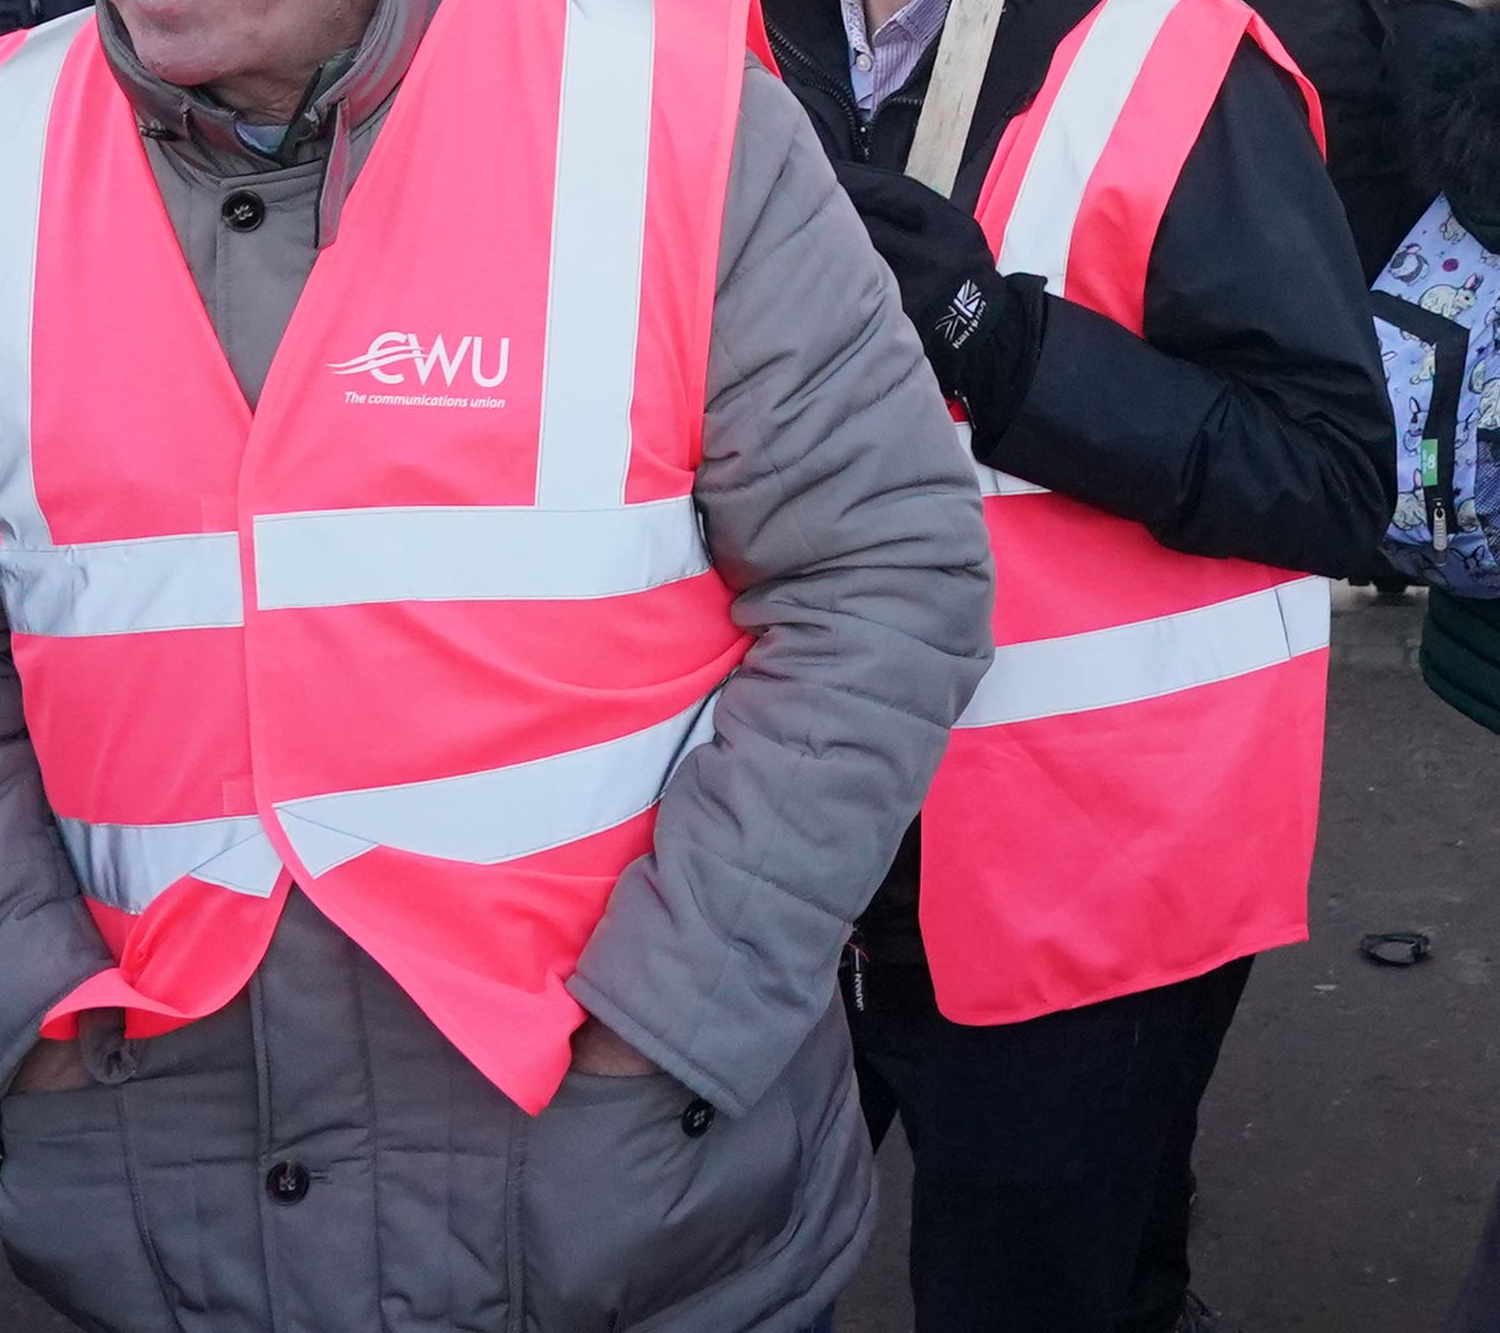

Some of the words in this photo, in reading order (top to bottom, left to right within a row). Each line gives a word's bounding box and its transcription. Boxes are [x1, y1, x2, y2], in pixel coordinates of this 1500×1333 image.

[362, 331, 510, 389] CWU
[344, 391, 367, 404] The
[367, 393, 469, 409] communications
[469, 396, 507, 409] union
